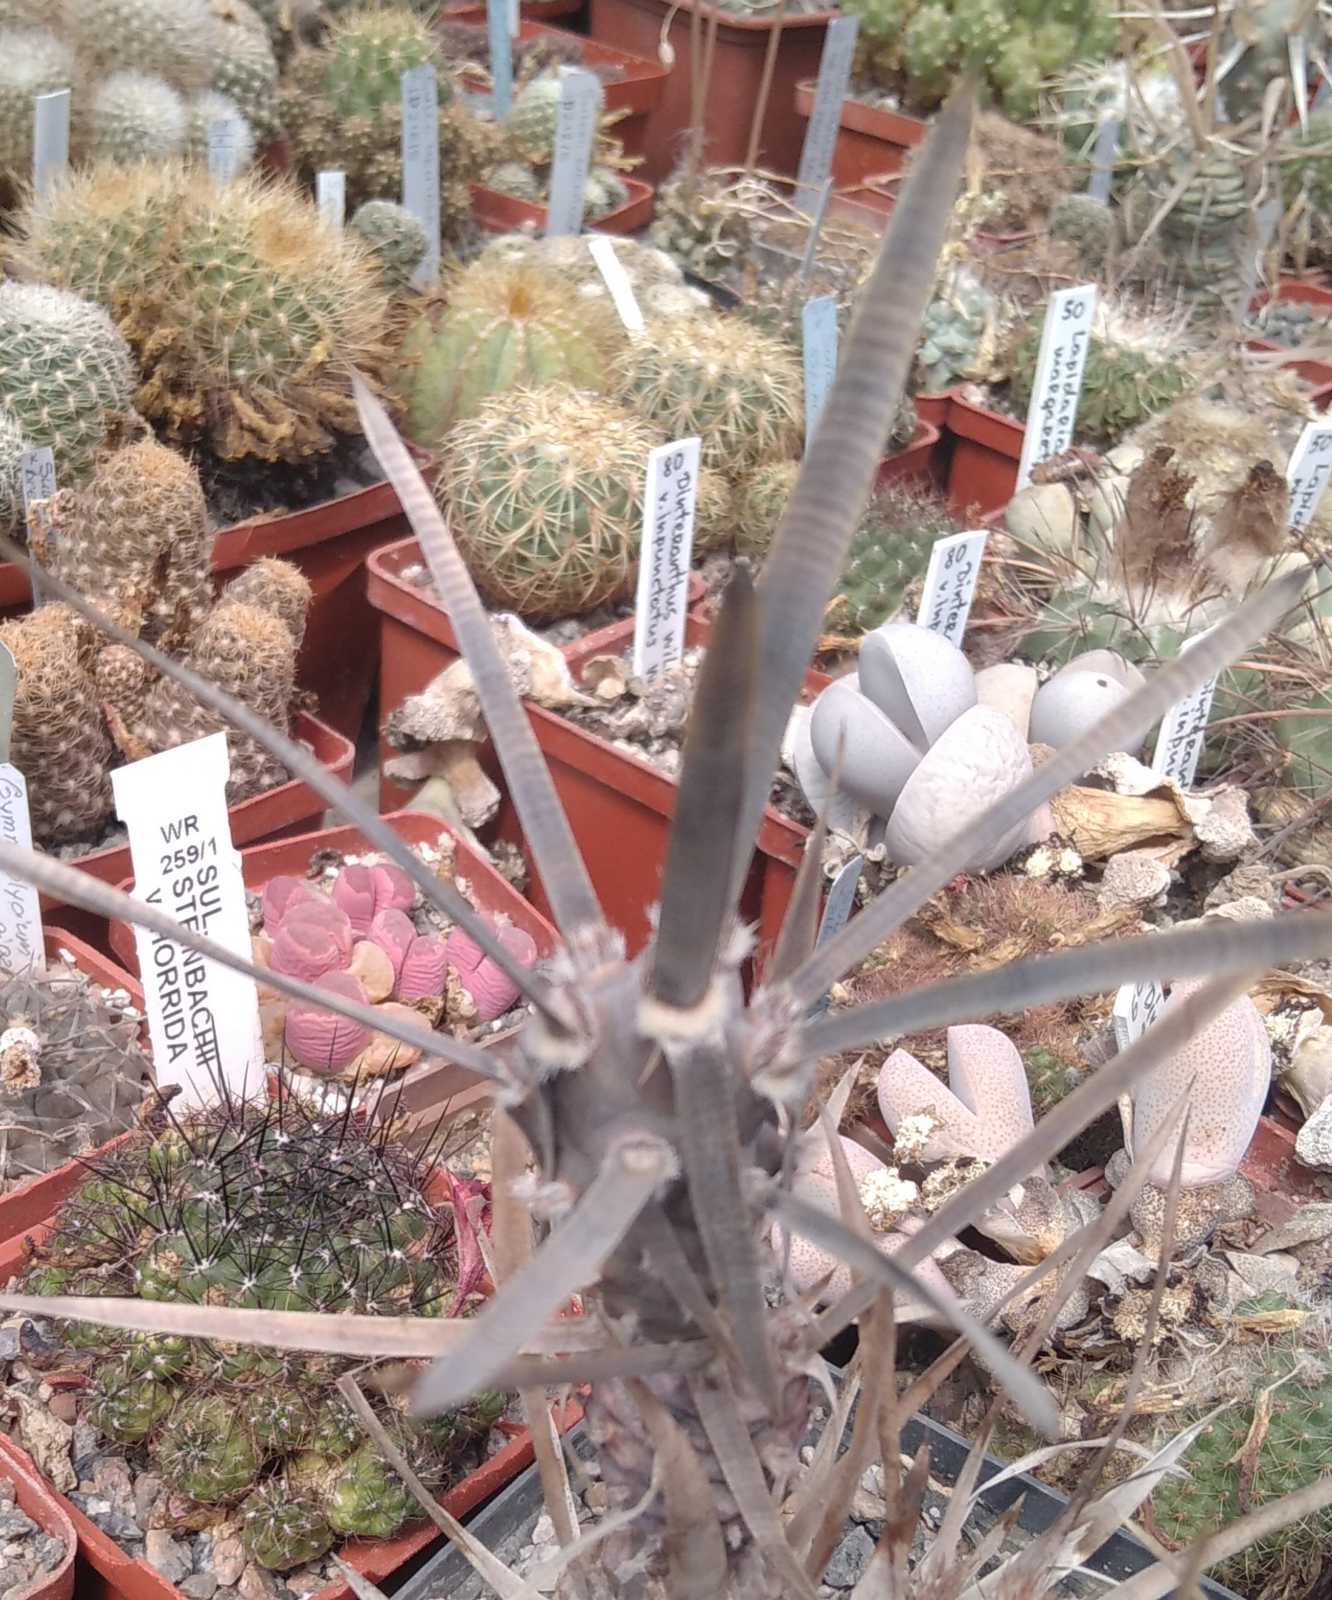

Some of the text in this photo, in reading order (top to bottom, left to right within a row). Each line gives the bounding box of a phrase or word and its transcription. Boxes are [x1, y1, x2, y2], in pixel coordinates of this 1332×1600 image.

[1061, 299, 1085, 320] 50
[944, 543, 968, 569] 80
[160, 814, 200, 844] WR
[160, 836, 218, 875] 259/1
[172, 876, 217, 1067] STENBACHII
